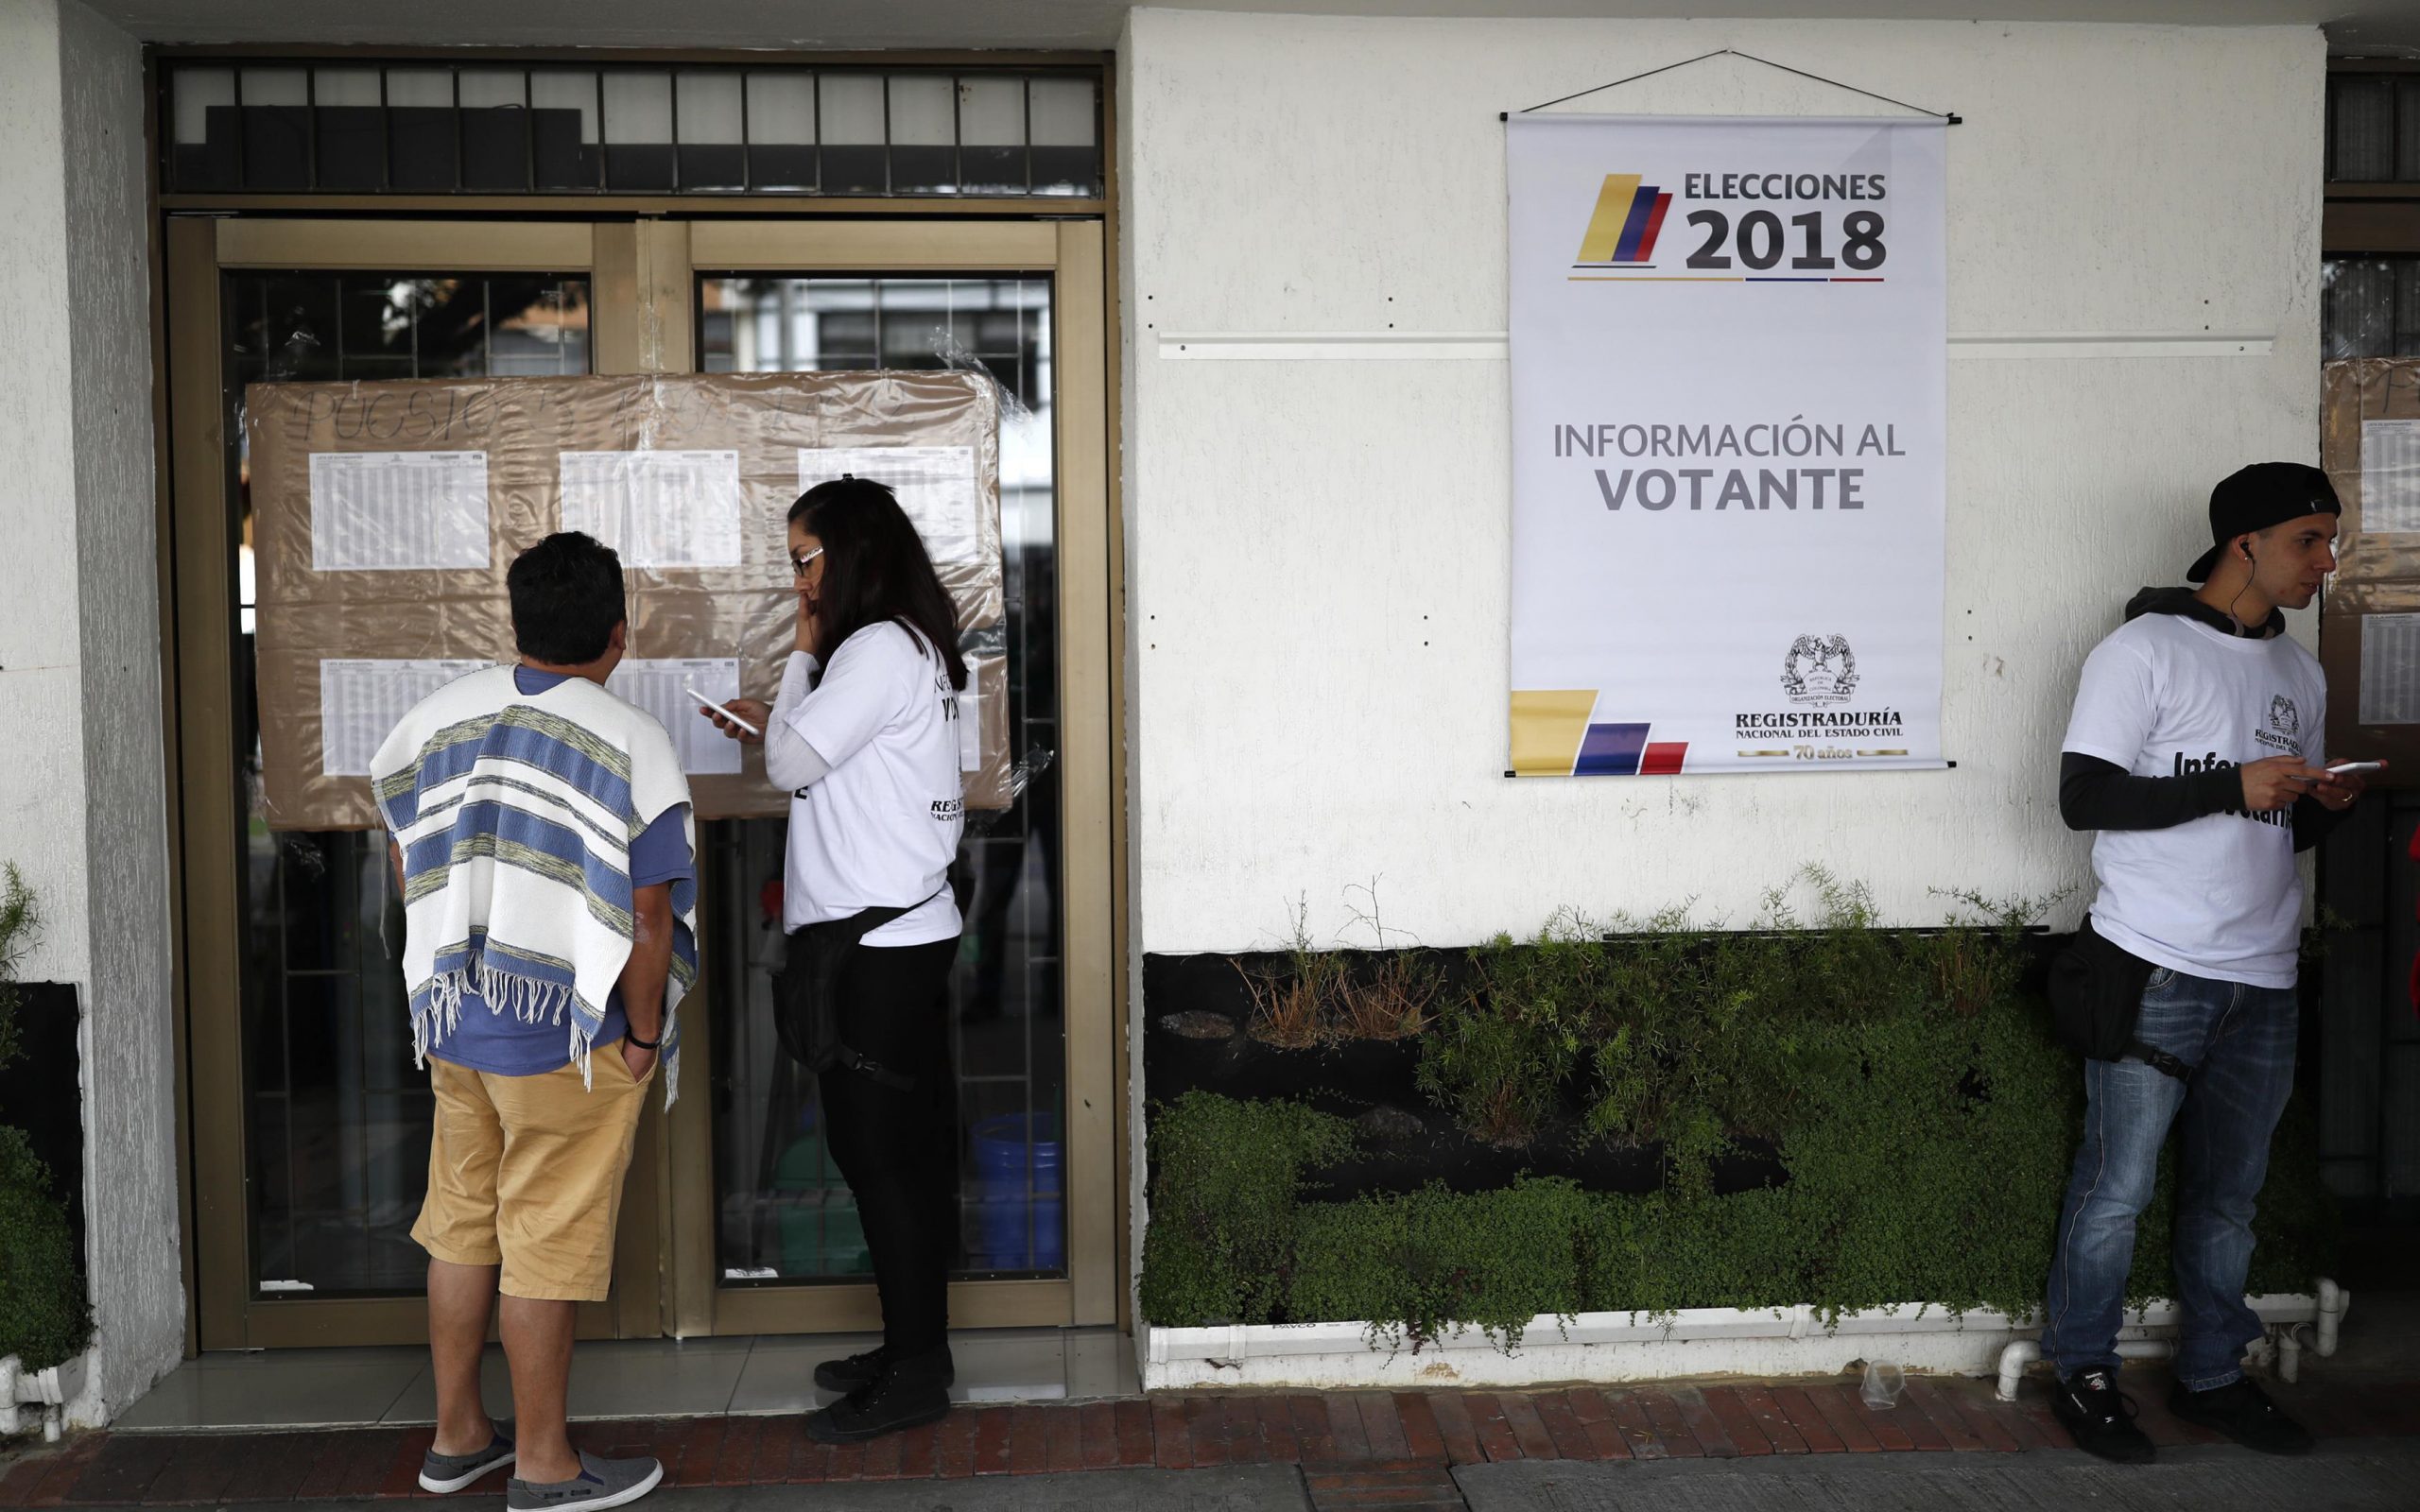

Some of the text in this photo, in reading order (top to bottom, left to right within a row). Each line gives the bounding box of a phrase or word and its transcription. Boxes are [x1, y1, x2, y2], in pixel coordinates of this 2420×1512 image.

[1685, 173, 1886, 200] ELECCIONES
[1685, 210, 1887, 271] 2018
[1554, 414, 1906, 457] INFORMACIÓN AL
[1594, 469, 1865, 511] VOTANTE
[1736, 707, 1903, 728] REGISTRADURÍA
[1736, 728, 1903, 739] NACIONAL DEL ESTADO CIVIL
[1794, 745, 1853, 760] 70 años
